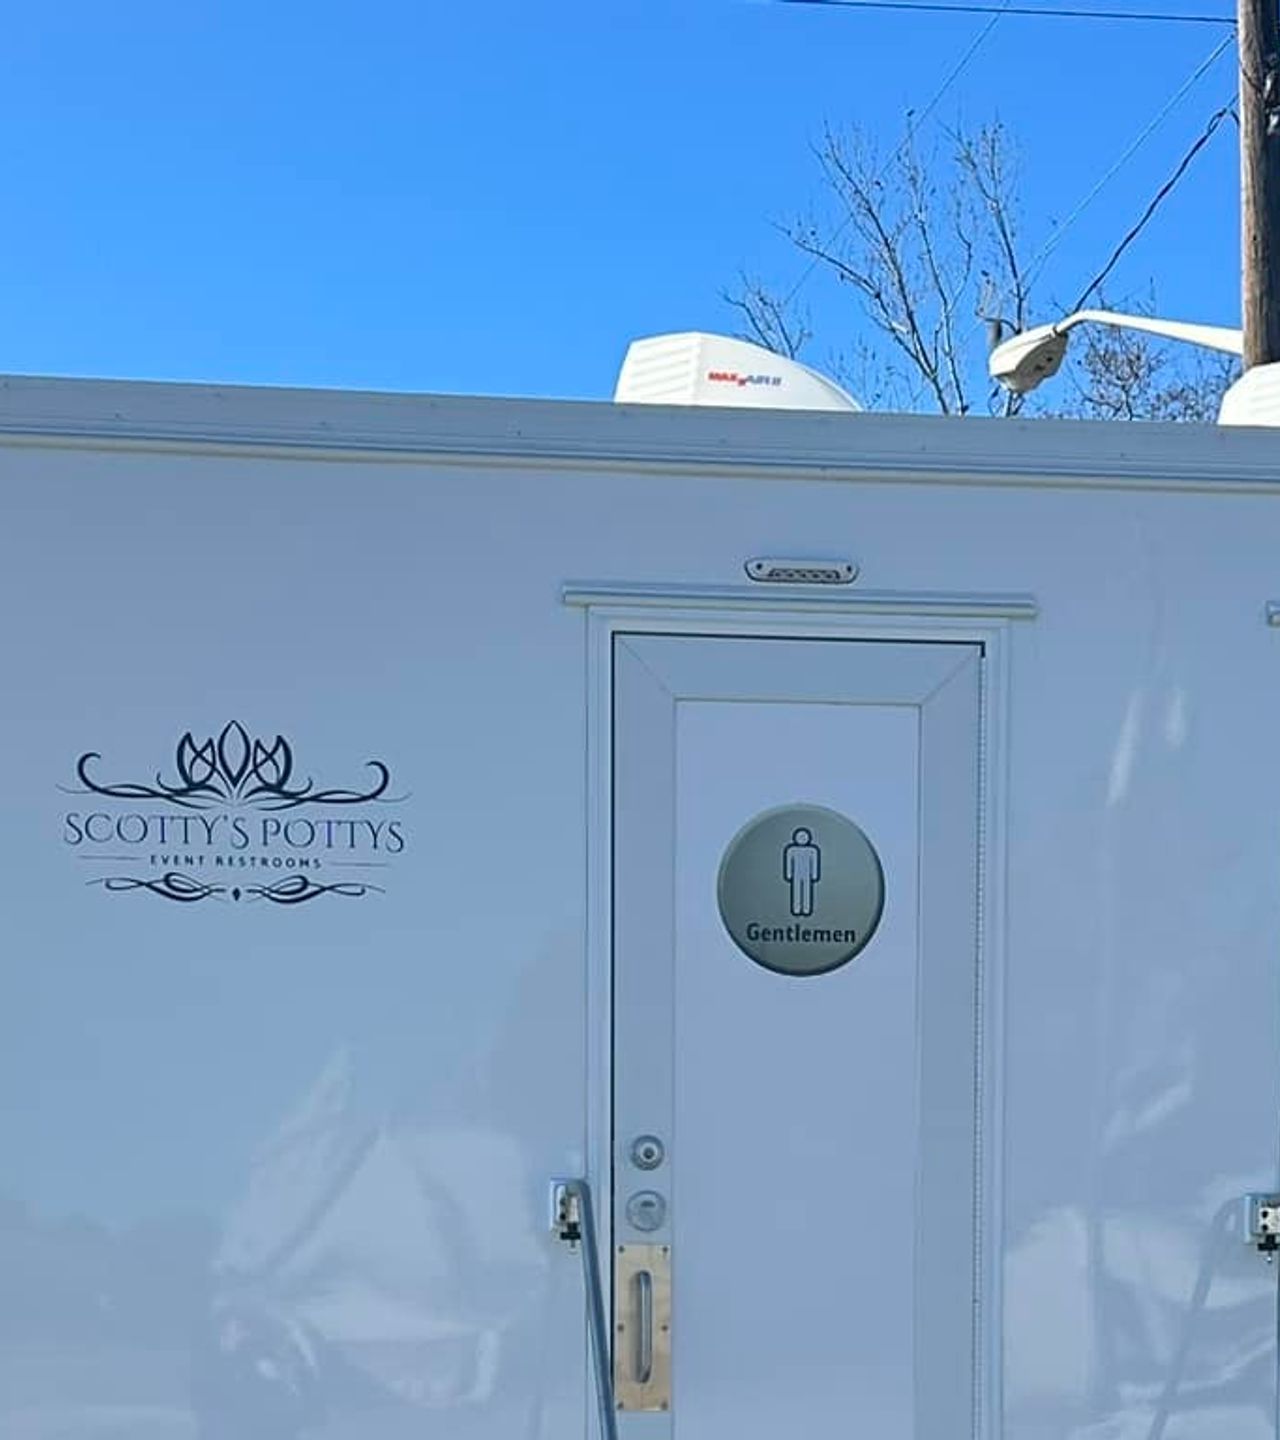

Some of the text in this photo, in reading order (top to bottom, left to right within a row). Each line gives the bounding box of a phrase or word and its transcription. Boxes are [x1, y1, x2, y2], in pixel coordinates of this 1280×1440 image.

[64, 812, 405, 853] SCOTTY'S POTTYS
[150, 855, 322, 869] EVENT RESTROOMS
[746, 922, 856, 944] Gentlemen
